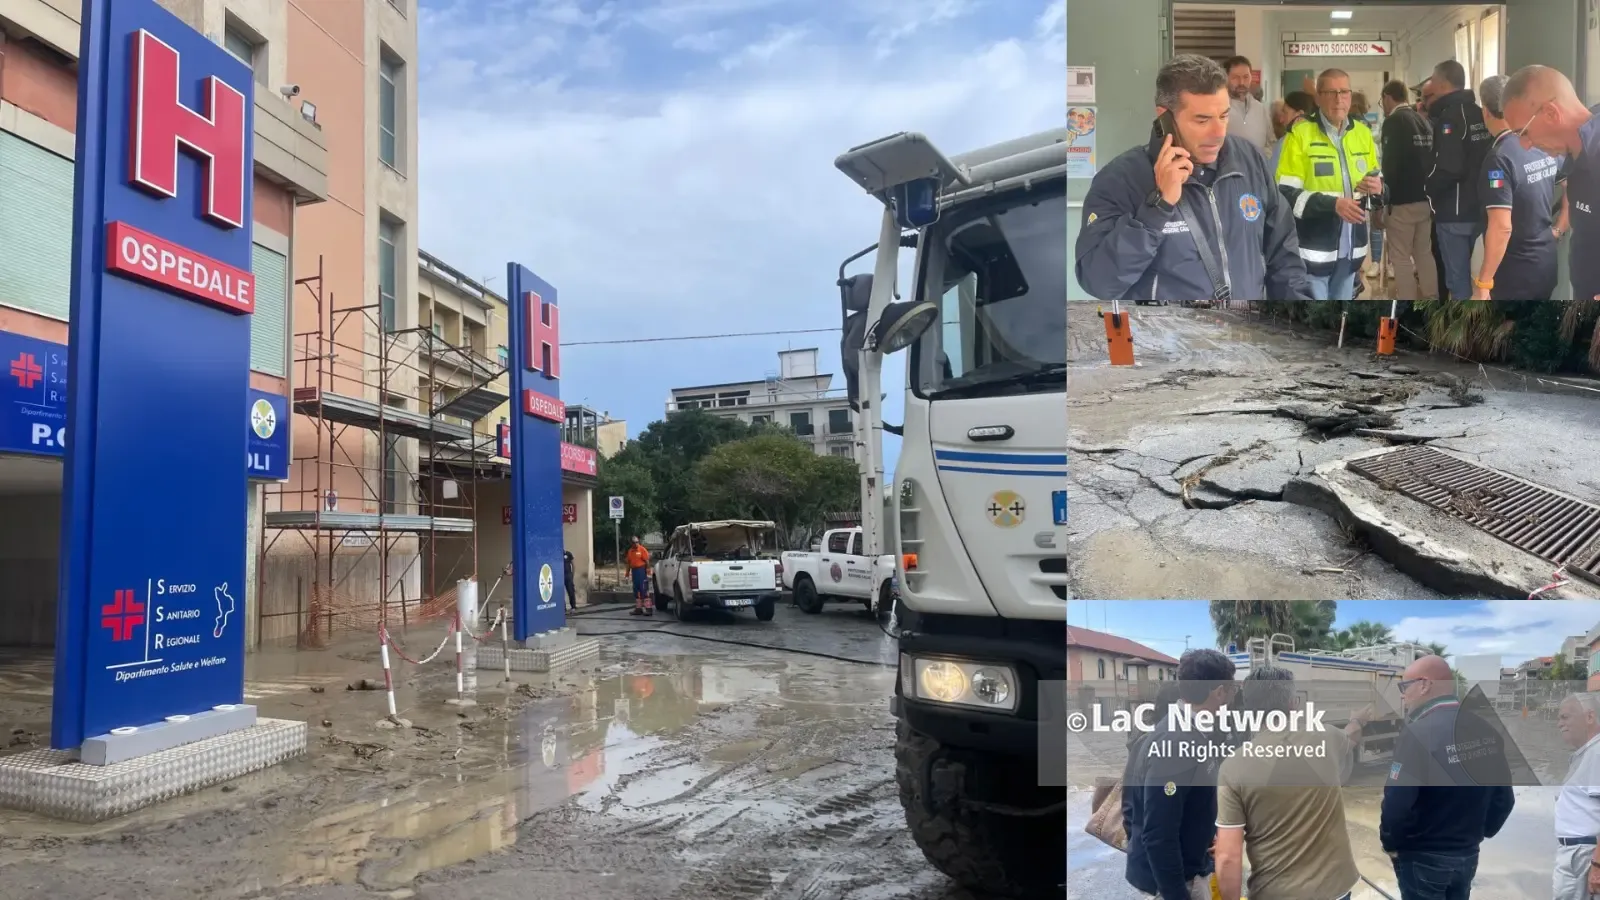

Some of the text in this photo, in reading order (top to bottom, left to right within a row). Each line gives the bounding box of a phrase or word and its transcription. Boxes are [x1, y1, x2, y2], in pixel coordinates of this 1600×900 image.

[1301, 43, 1368, 54] PRONTO SOCCORSO
[132, 28, 245, 228] H
[121, 236, 250, 304] OSPEDALE
[526, 290, 560, 379] H
[530, 396, 564, 418] OSPEDALE
[115, 665, 169, 682] Dipartimento
[170, 660, 193, 673] Salute
[200, 656, 226, 667] Welfare
